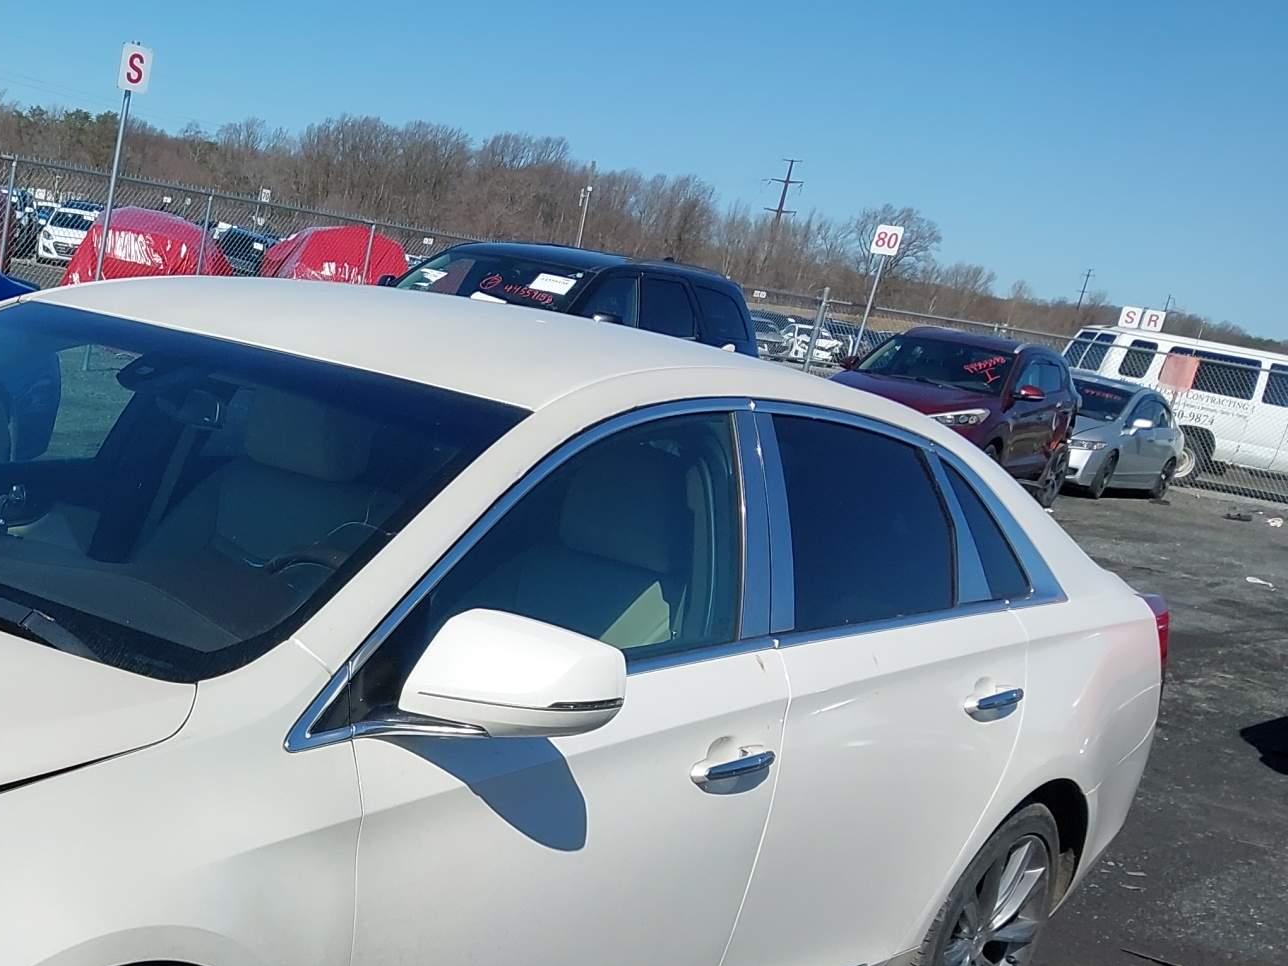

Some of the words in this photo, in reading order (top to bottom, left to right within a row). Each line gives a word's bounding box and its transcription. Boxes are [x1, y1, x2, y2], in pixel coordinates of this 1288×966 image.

[126, 52, 145, 84] S
[874, 231, 899, 249] 80
[1124, 310, 1137, 324] S
[1147, 314, 1160, 328] R
